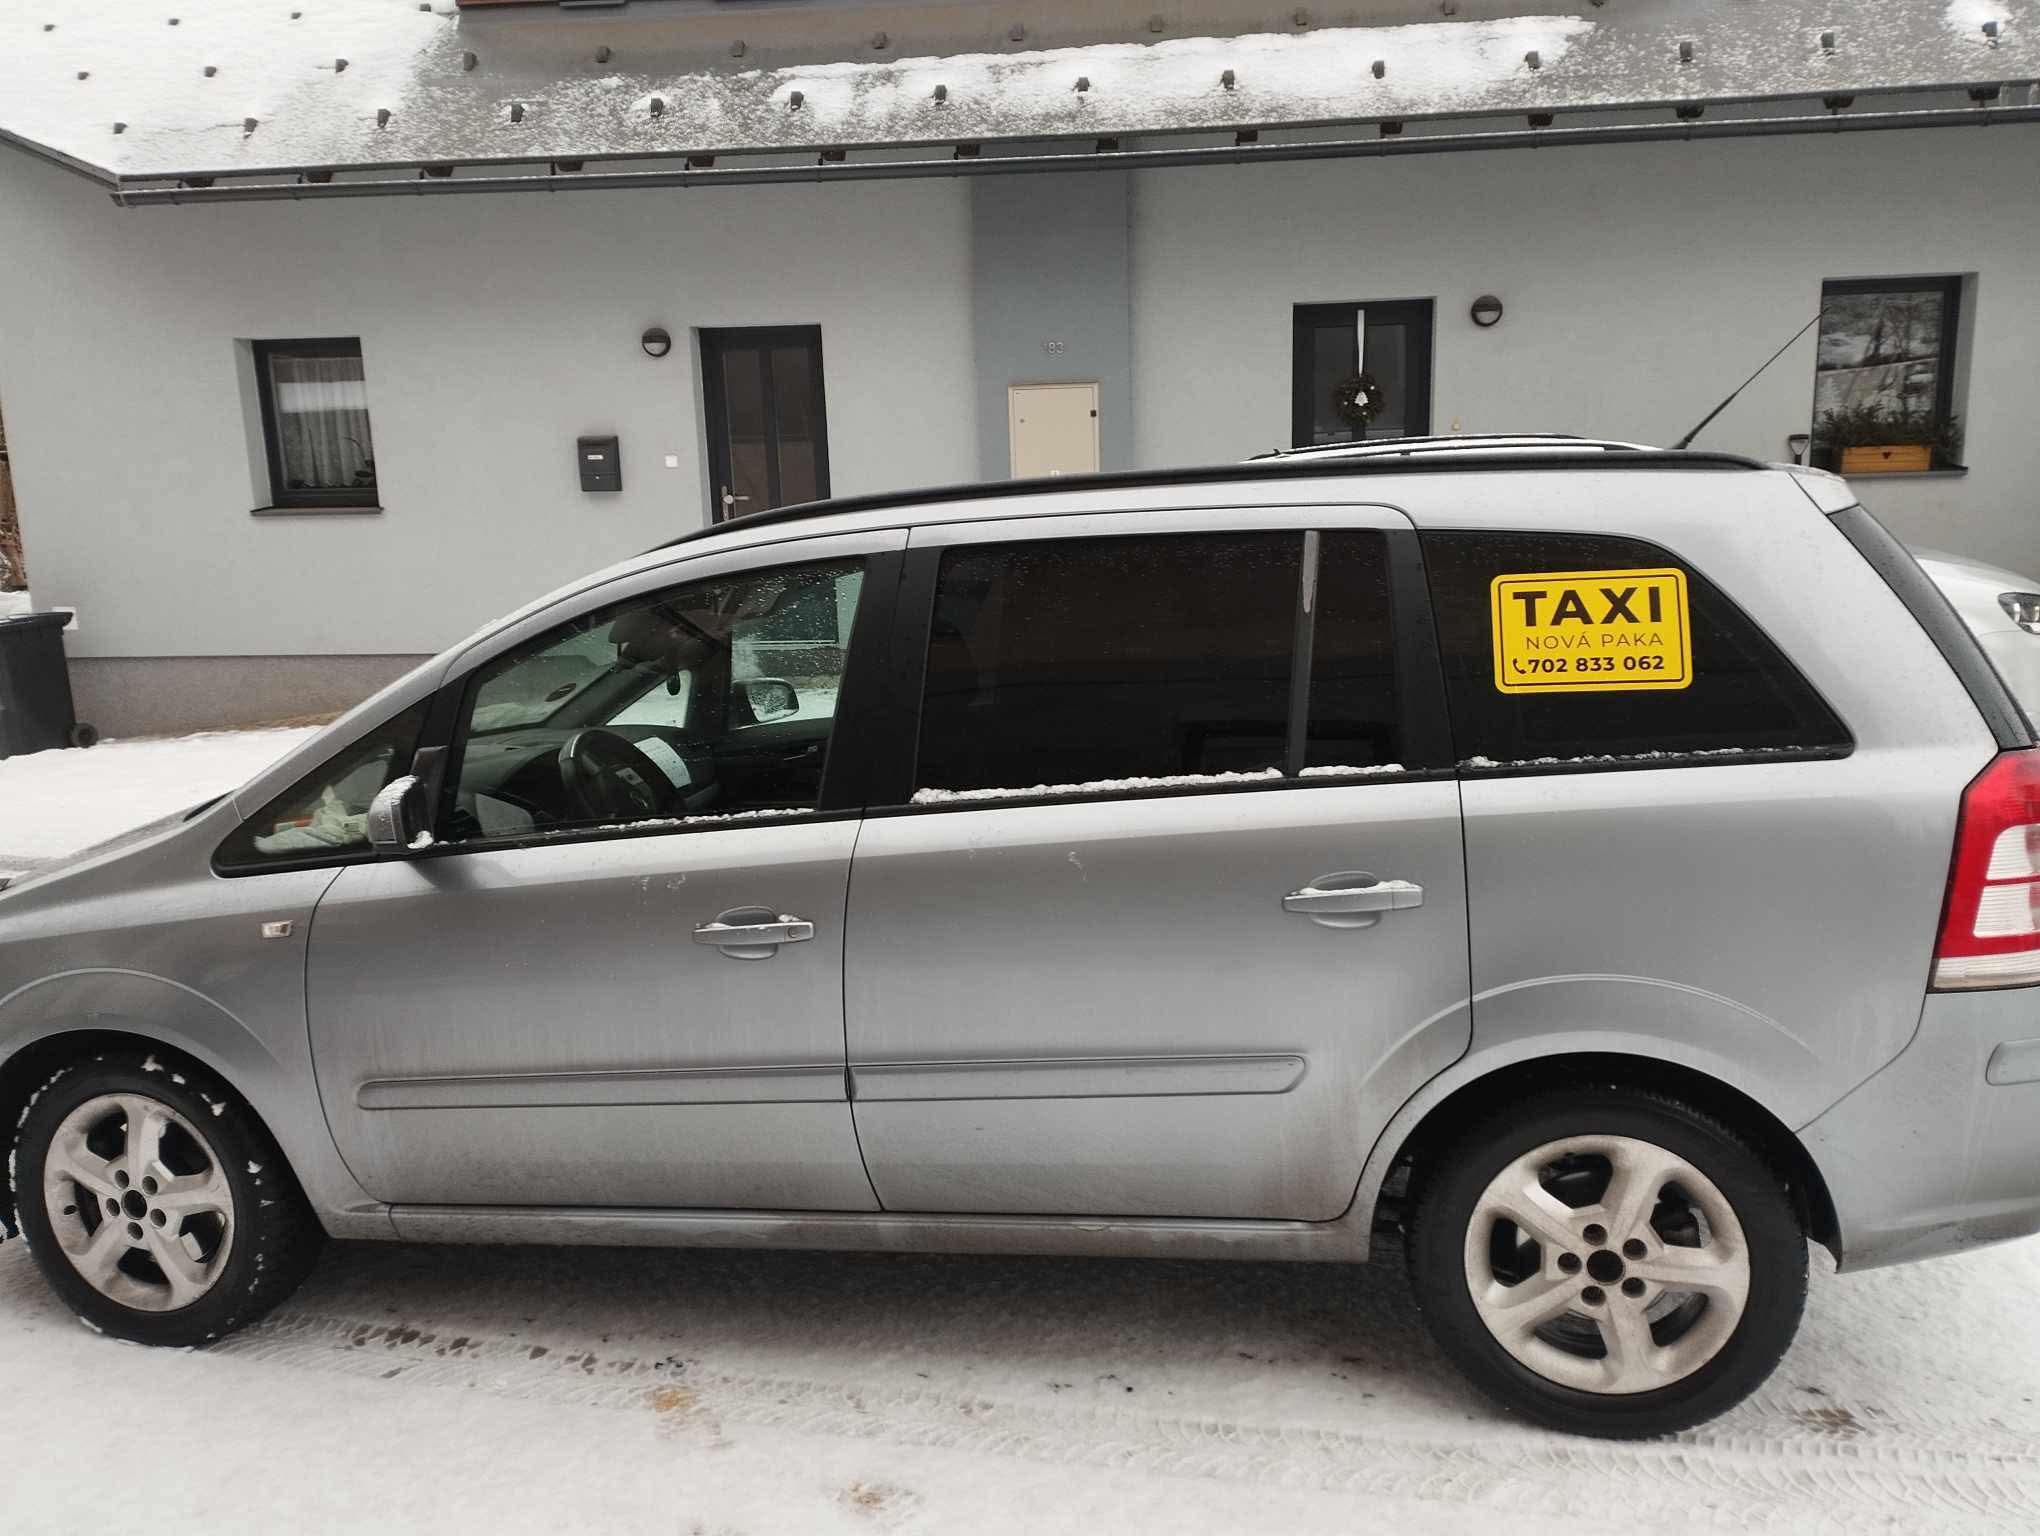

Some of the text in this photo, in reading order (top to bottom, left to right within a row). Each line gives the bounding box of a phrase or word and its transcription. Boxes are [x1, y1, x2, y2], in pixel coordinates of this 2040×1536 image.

[1512, 586, 1662, 627] TAXI
[1526, 631, 1664, 650] NOVÁ PAKA
[1528, 655, 1664, 673] 702 833 062
